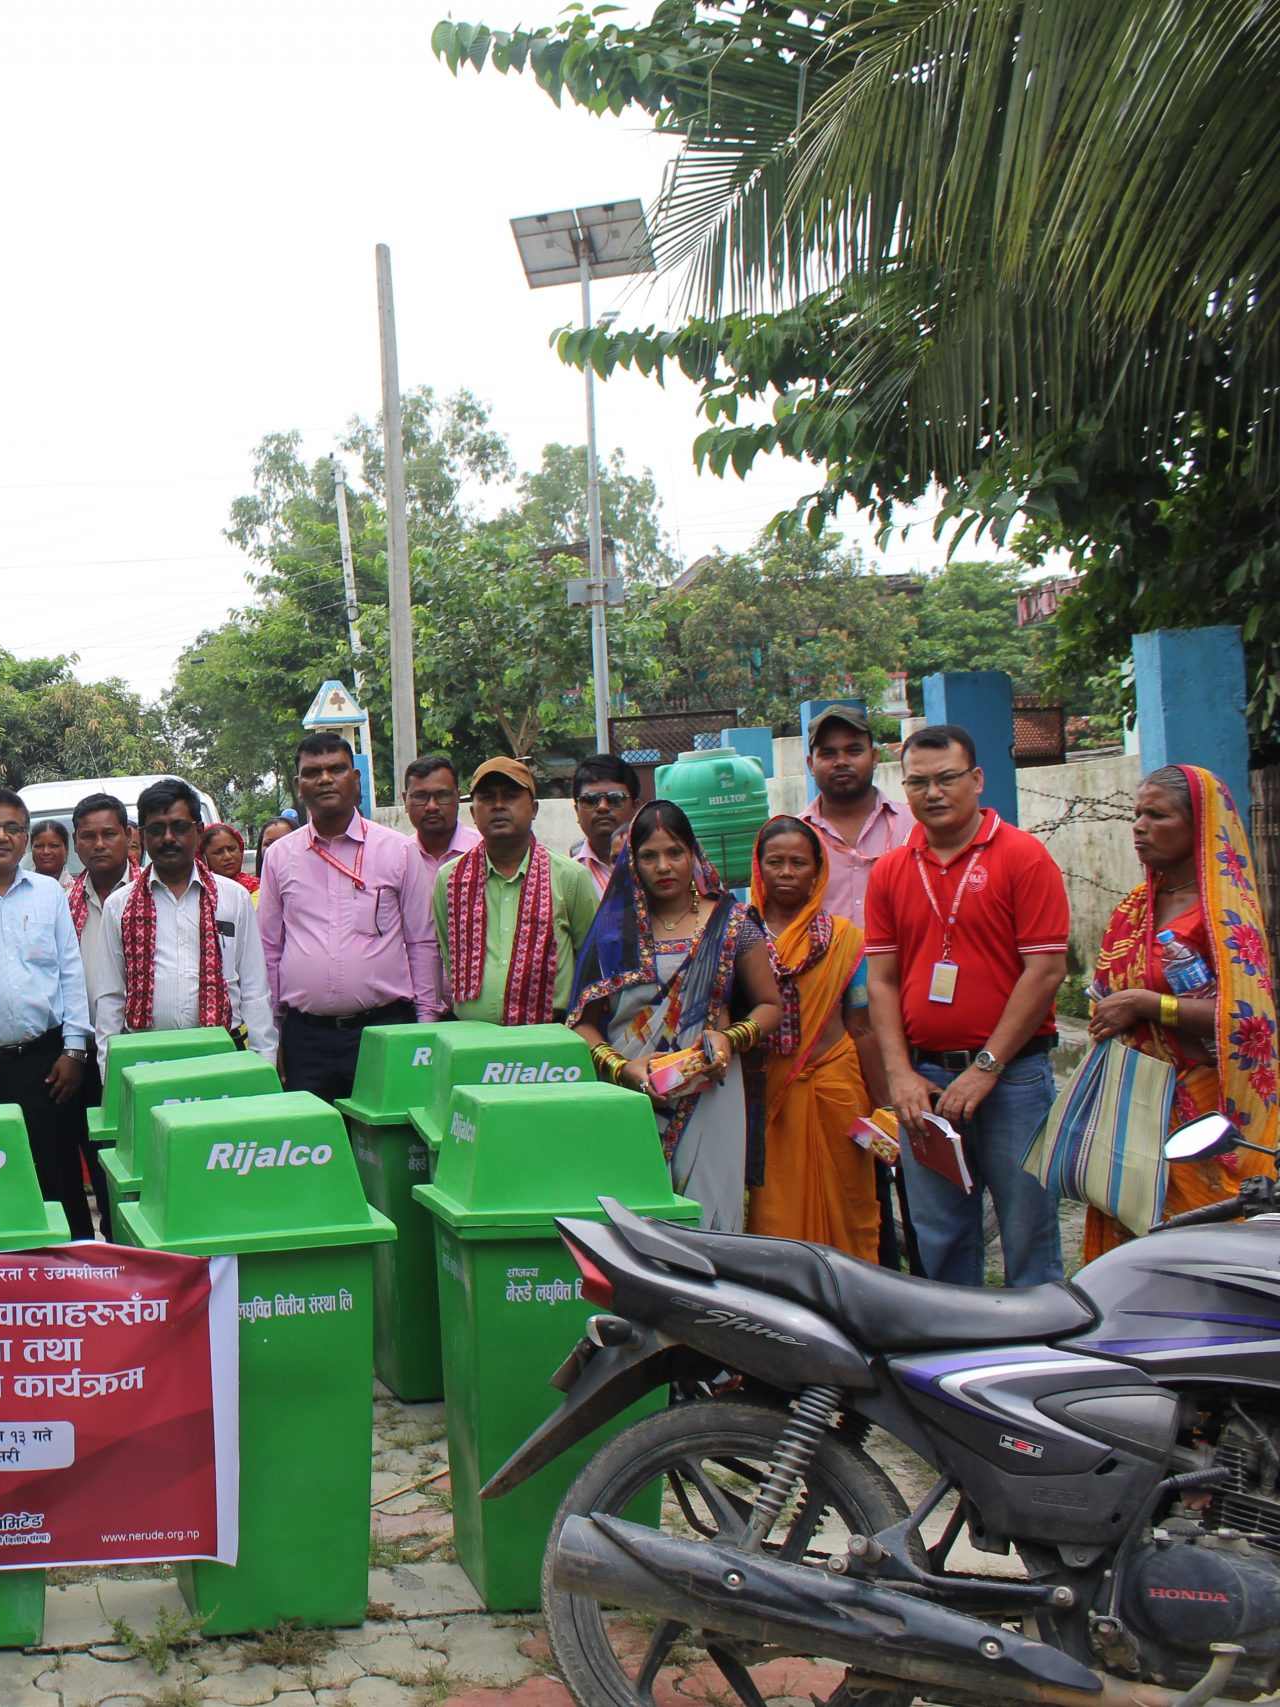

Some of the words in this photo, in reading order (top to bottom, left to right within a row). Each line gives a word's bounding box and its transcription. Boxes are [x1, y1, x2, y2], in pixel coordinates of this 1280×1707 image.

[708, 793, 747, 806] HILLTOP
[482, 1061, 581, 1085] Rijalco
[206, 1140, 333, 1176] Rijalco
[28, 1267, 39, 1282] र
[274, 1293, 305, 1316] वित्तीय
[308, 1293, 336, 1315] संस्था
[339, 1288, 352, 1311] लि
[693, 1309, 808, 1346] Shine
[23, 1338, 84, 1364] तथा
[13, 1366, 146, 1399] कार्यक्रम
[10, 1430, 26, 1445] १३
[32, 1426, 53, 1443] गते
[101, 1529, 200, 1543] www.nerude.org.np
[1148, 1587, 1231, 1604] HONDA
